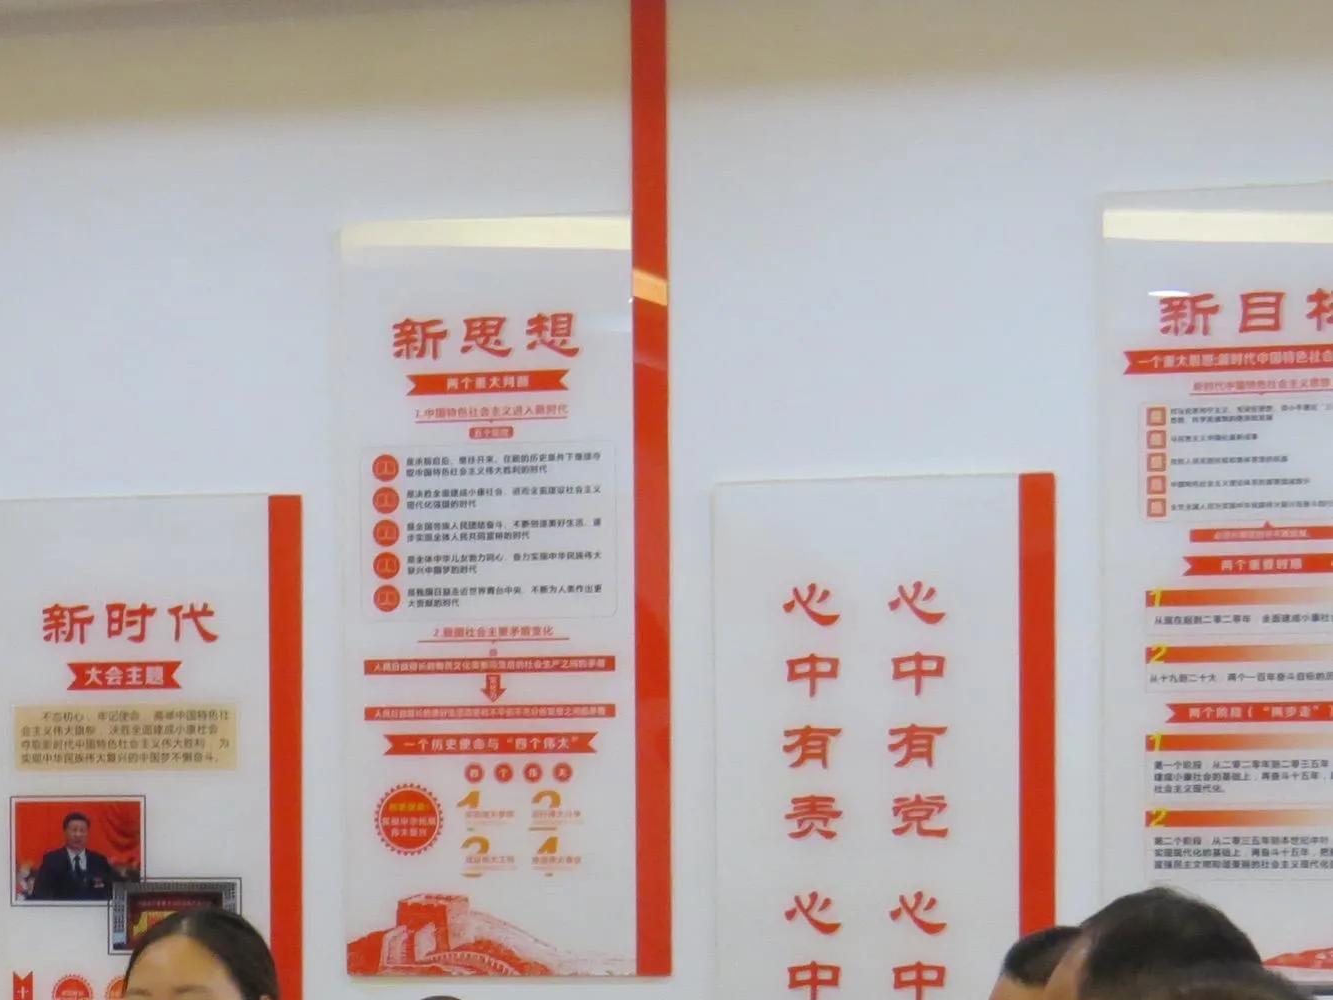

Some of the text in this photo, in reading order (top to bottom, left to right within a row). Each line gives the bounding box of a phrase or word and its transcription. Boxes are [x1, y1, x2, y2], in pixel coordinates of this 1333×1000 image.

[392, 312, 581, 360] 新思想
[42, 603, 219, 644] 新时代
[84, 667, 165, 686] 大会主题
[782, 582, 843, 840] 心中有责
[887, 580, 949, 838] 心中有党
